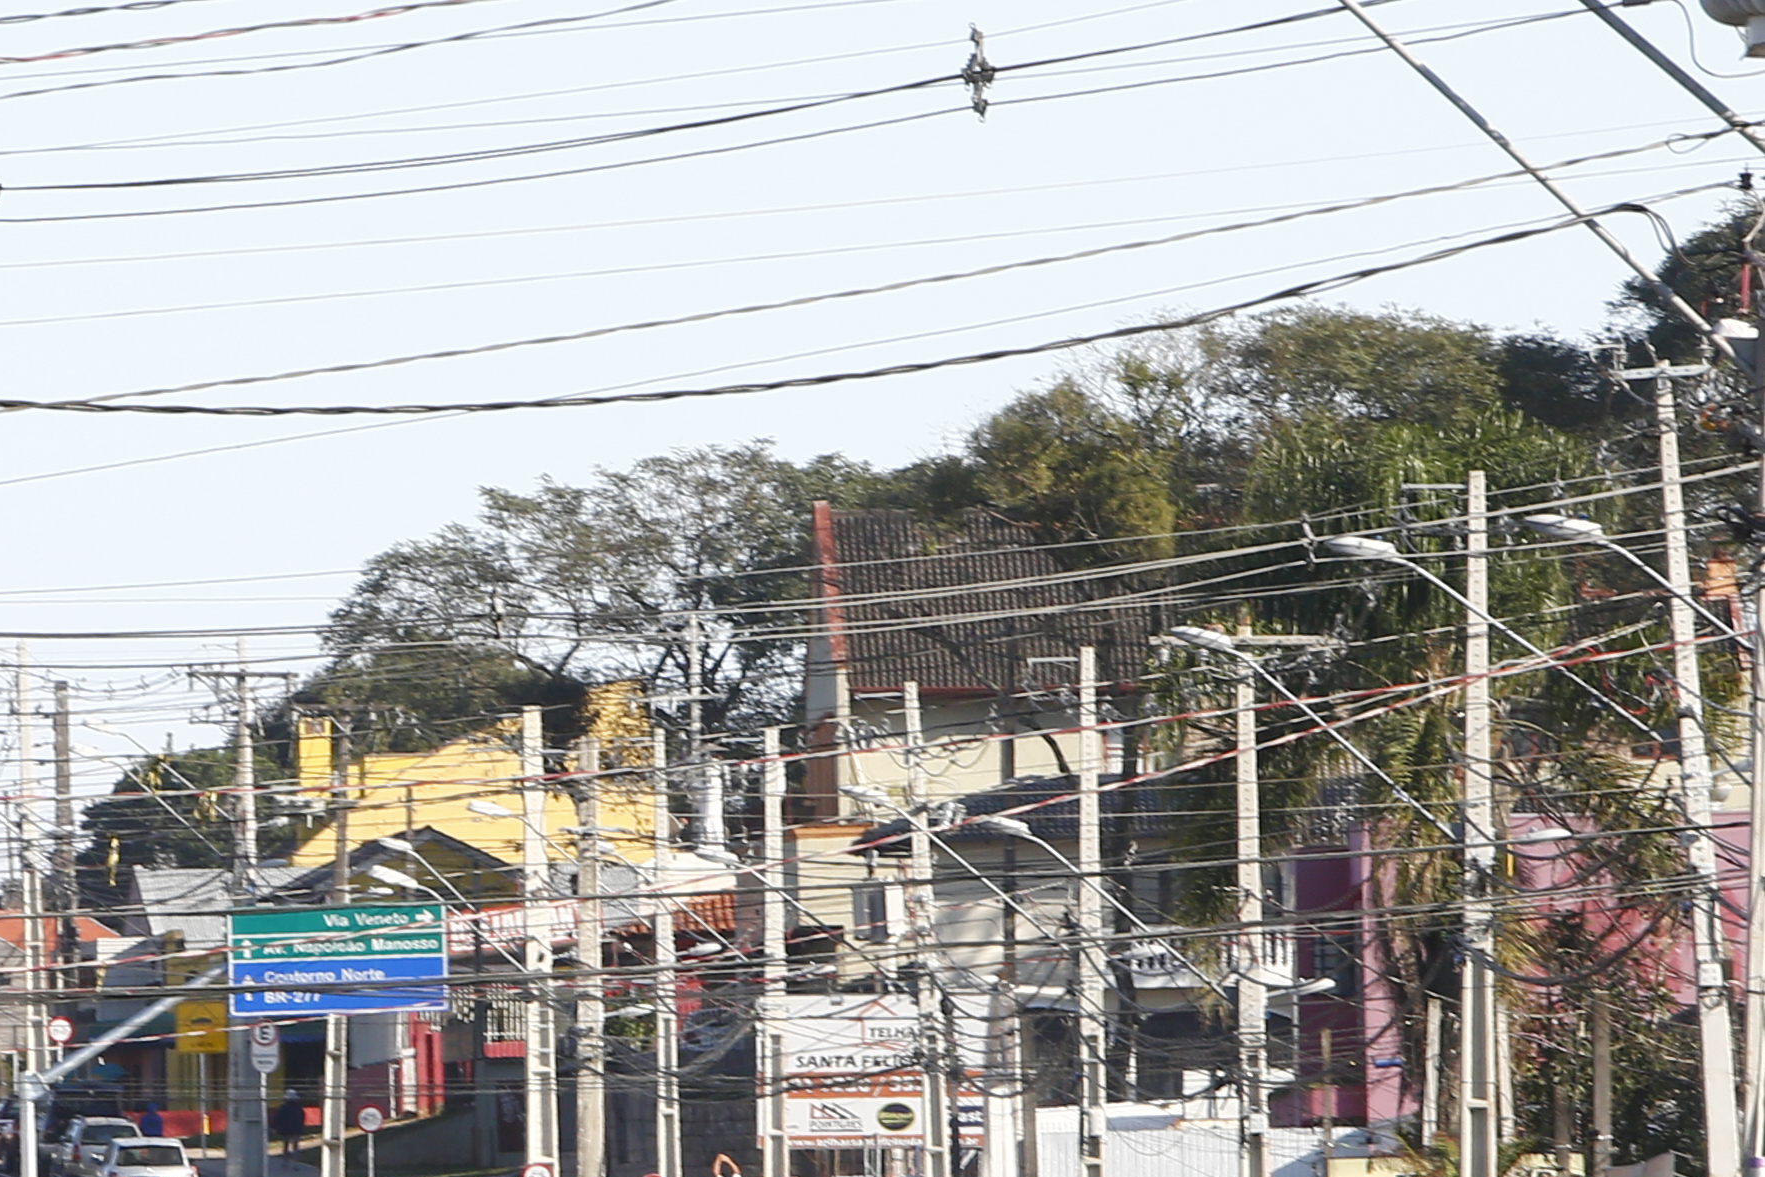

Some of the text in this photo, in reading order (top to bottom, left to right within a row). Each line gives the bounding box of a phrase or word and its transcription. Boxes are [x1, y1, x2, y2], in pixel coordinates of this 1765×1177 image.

[322, 912, 410, 928] Via Veneto
[370, 936, 440, 952] Manosso
[263, 967, 386, 984] Contorno Norte
[796, 1055, 856, 1069] SANTA
